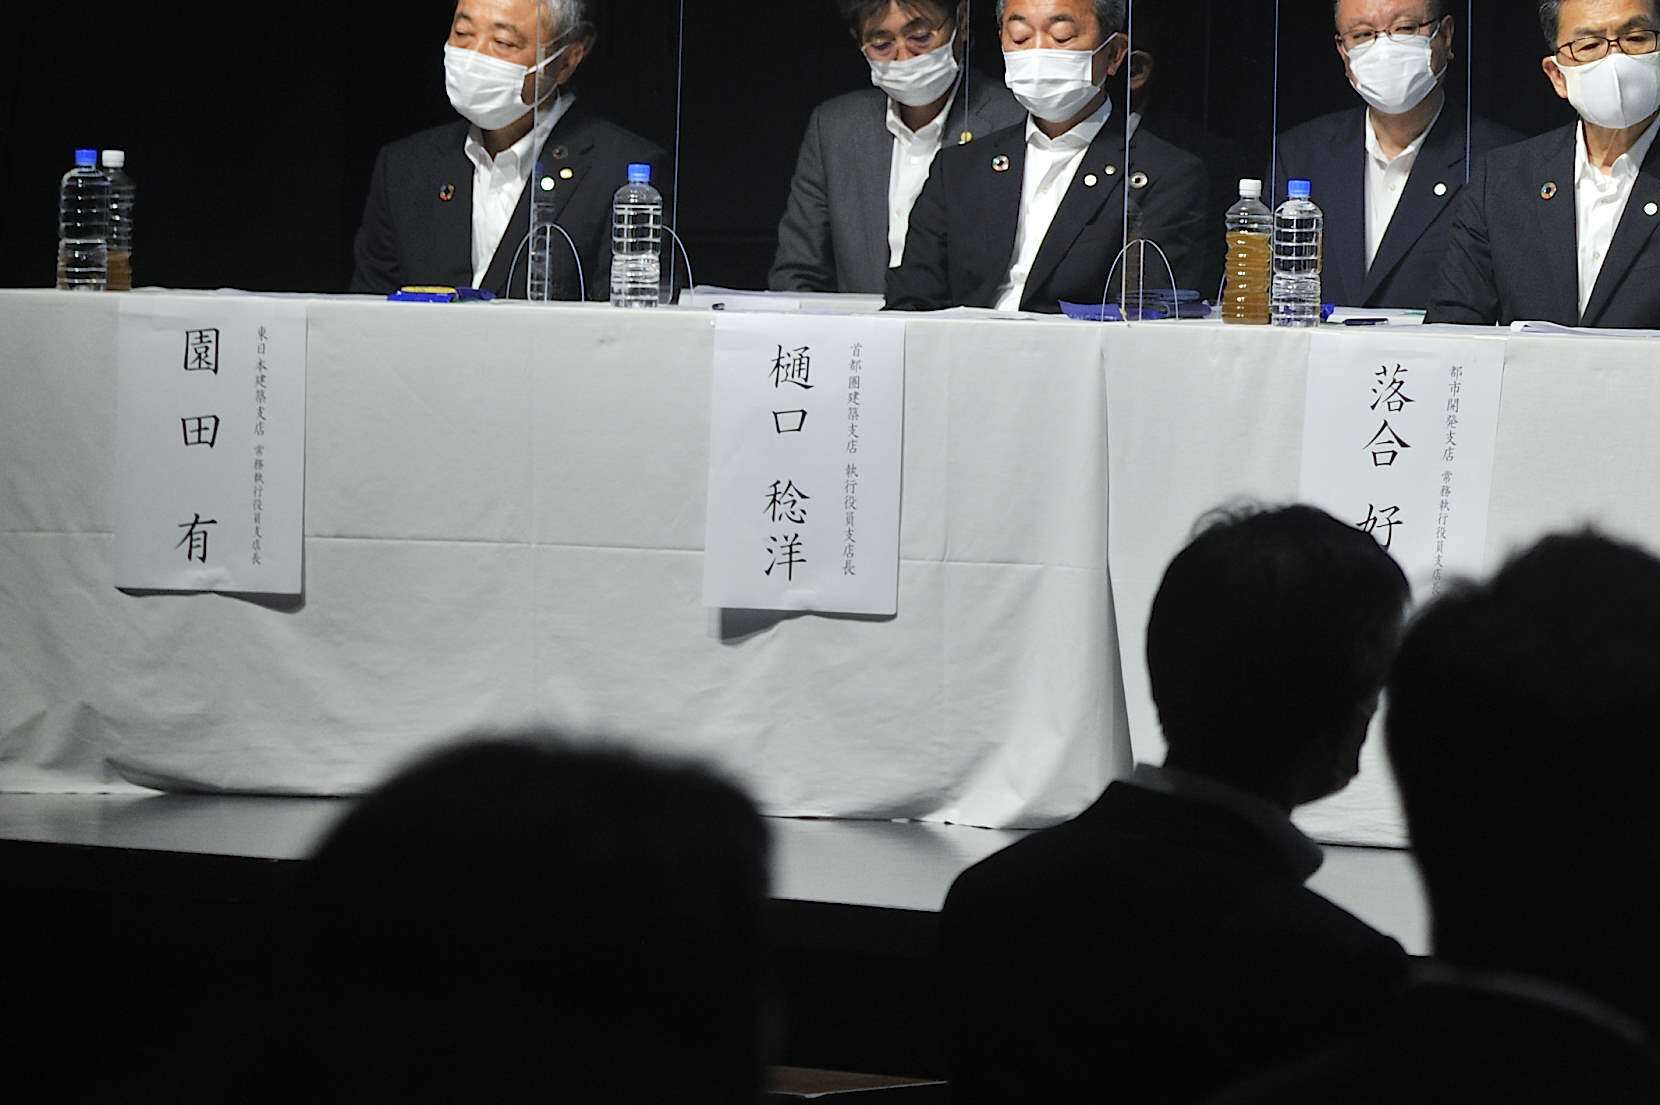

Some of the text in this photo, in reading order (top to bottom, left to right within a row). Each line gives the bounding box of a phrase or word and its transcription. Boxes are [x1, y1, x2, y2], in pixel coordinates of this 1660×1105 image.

[174, 328, 220, 564] 園田 有
[763, 344, 814, 582] 樋口 稔洋
[1363, 362, 1417, 468] 落合
[1442, 365, 1463, 463] 都市開発支店
